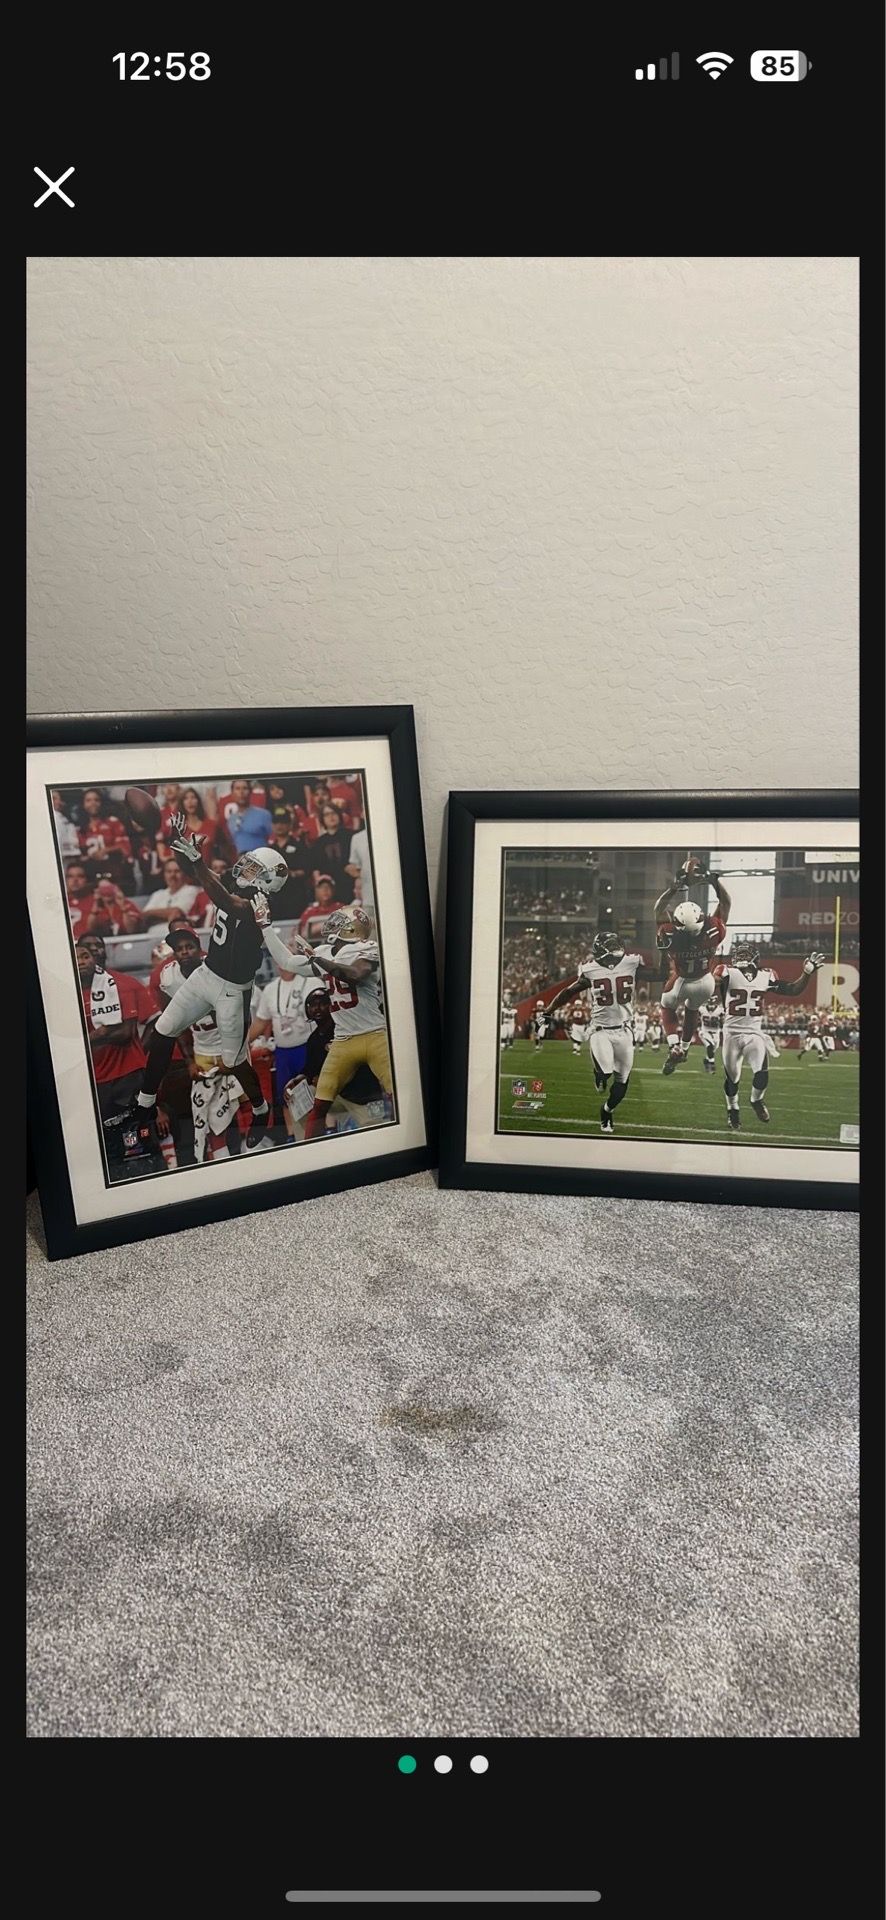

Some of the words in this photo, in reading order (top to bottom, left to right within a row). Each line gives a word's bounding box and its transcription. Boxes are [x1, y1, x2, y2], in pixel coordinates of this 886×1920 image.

[812, 869, 860, 884] UNIV
[593, 975, 634, 1007] 36
[816, 962, 860, 1008] R
[728, 988, 763, 1017] 23
